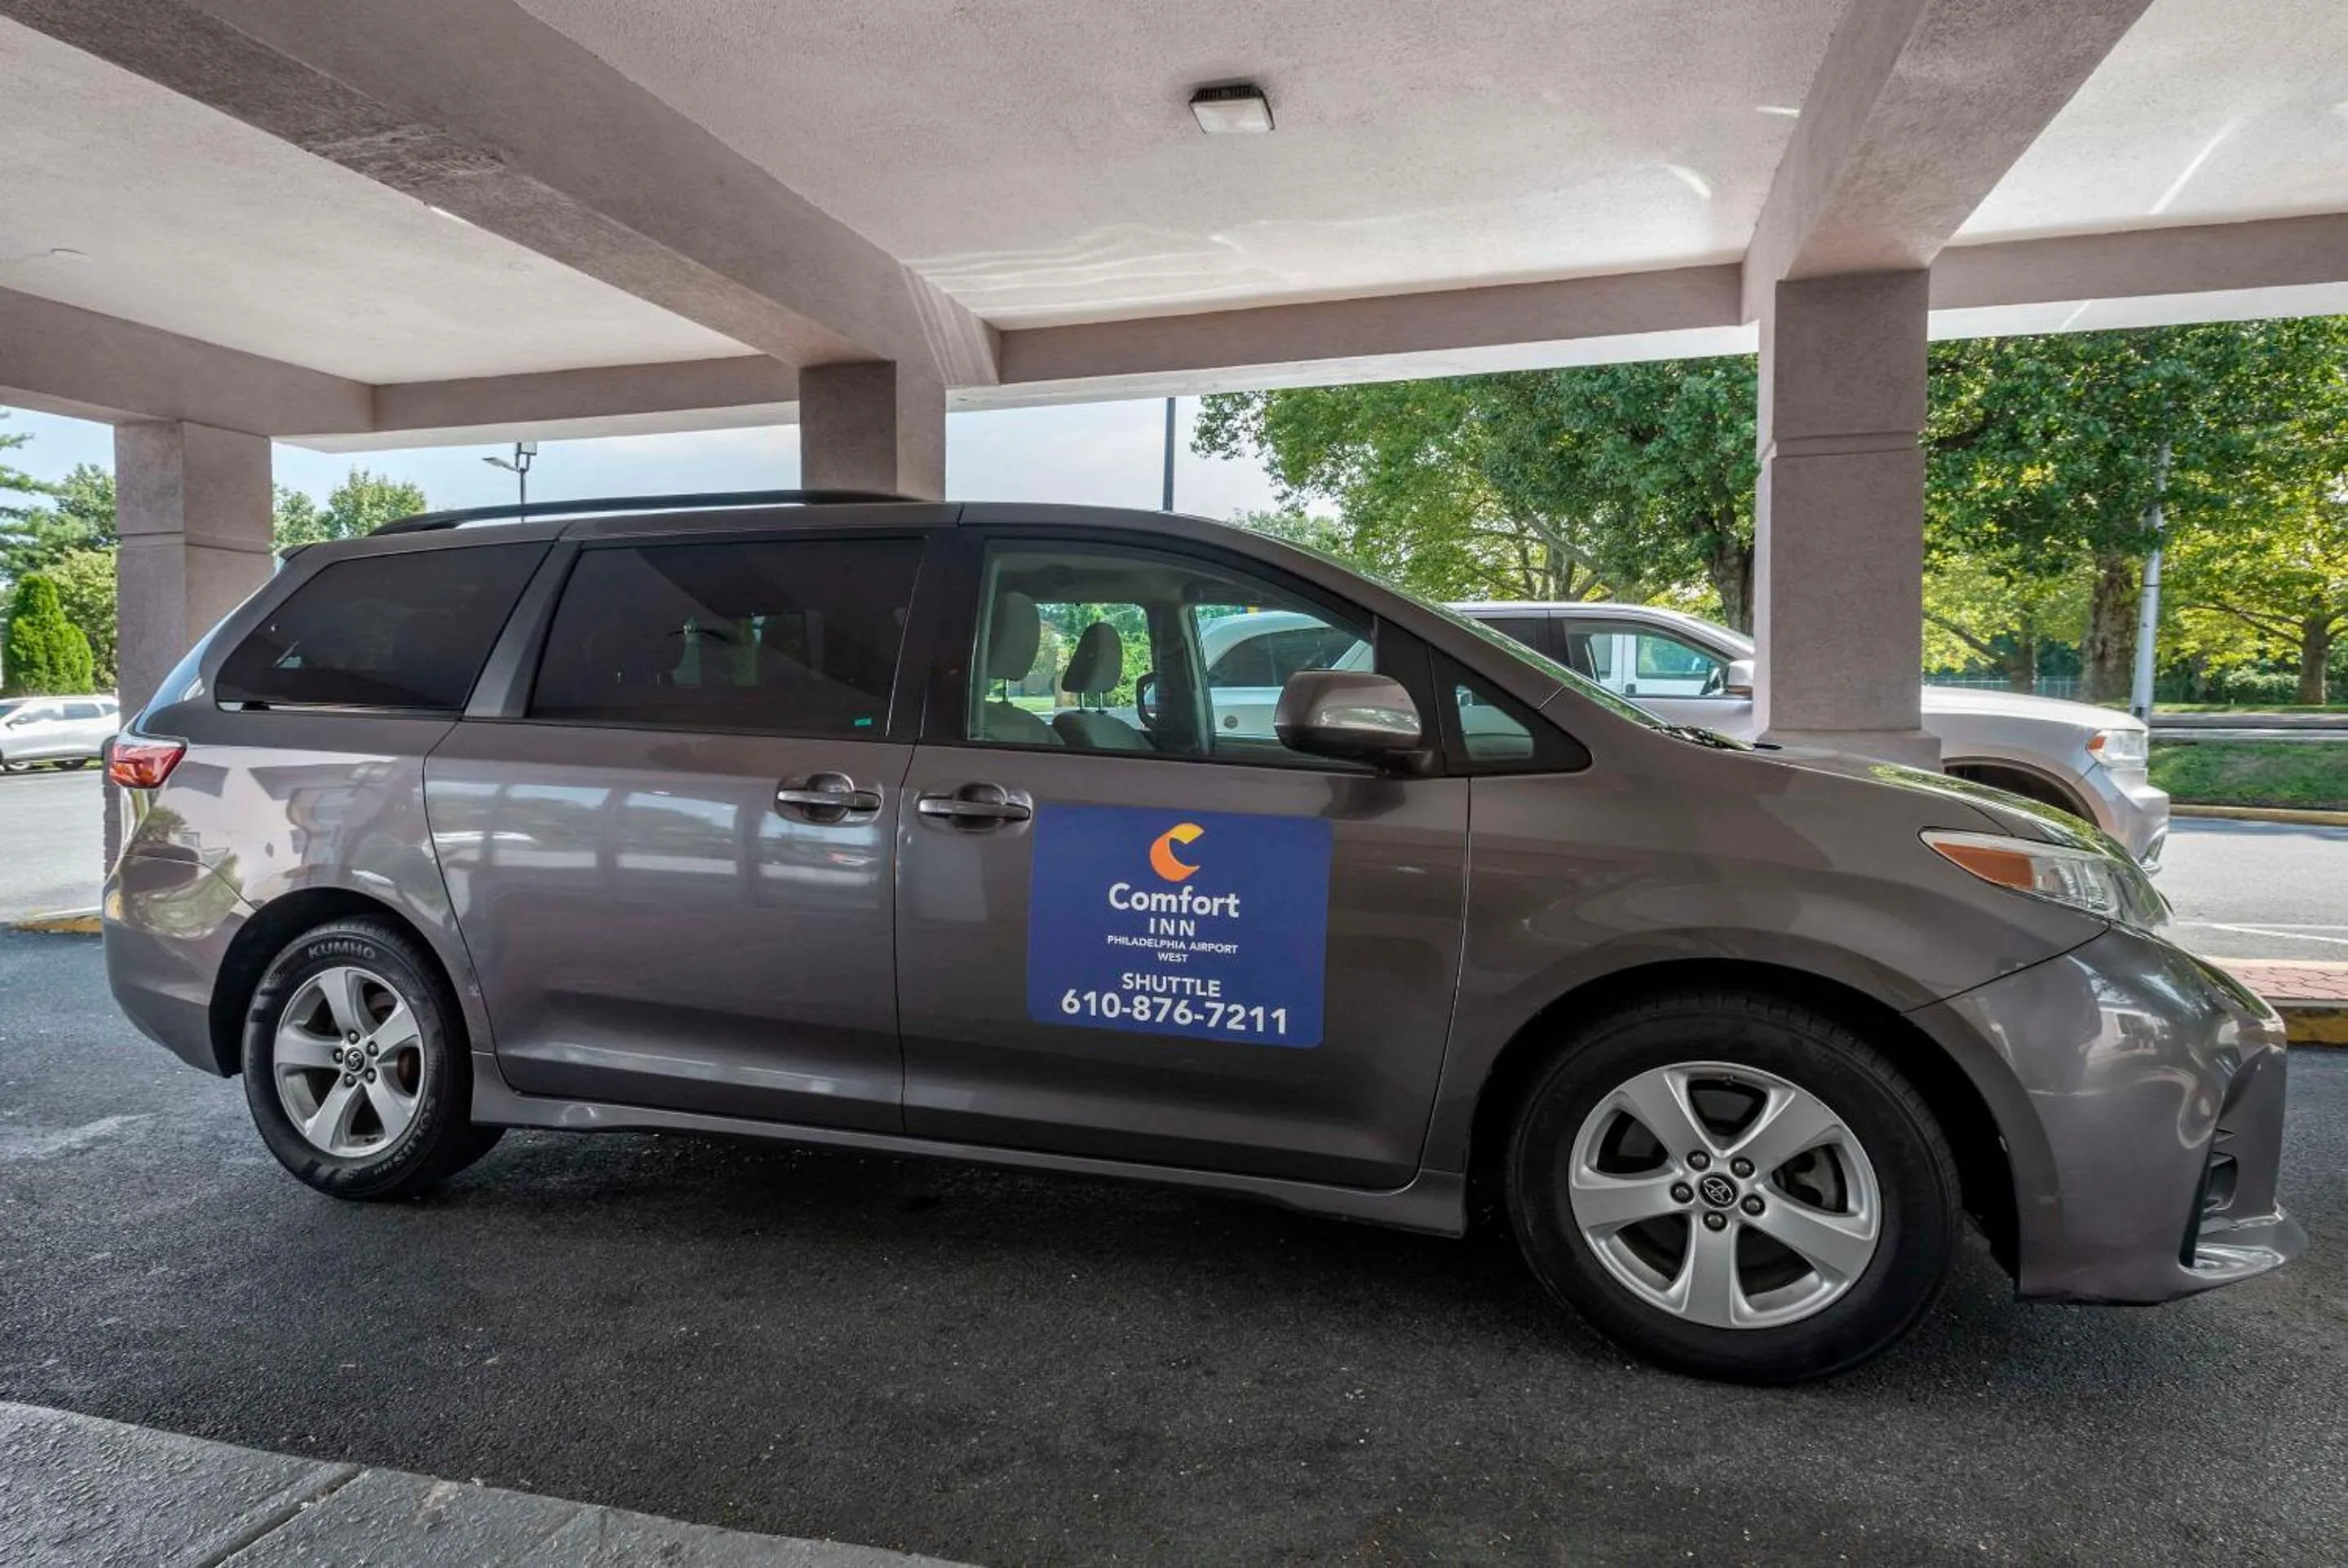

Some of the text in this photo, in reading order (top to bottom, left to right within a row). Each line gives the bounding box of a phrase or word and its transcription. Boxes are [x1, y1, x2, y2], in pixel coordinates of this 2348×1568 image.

[1108, 882, 1240, 918] Comfort
[1149, 917, 1196, 937] INN
[308, 940, 375, 960] KUMHO
[1107, 935, 1239, 954] PHILADELPHIA AIRPORT
[1157, 952, 1188, 963] WEST
[1122, 973, 1221, 997] SHUTTLE
[1061, 989, 1287, 1035] 610-876-7211
